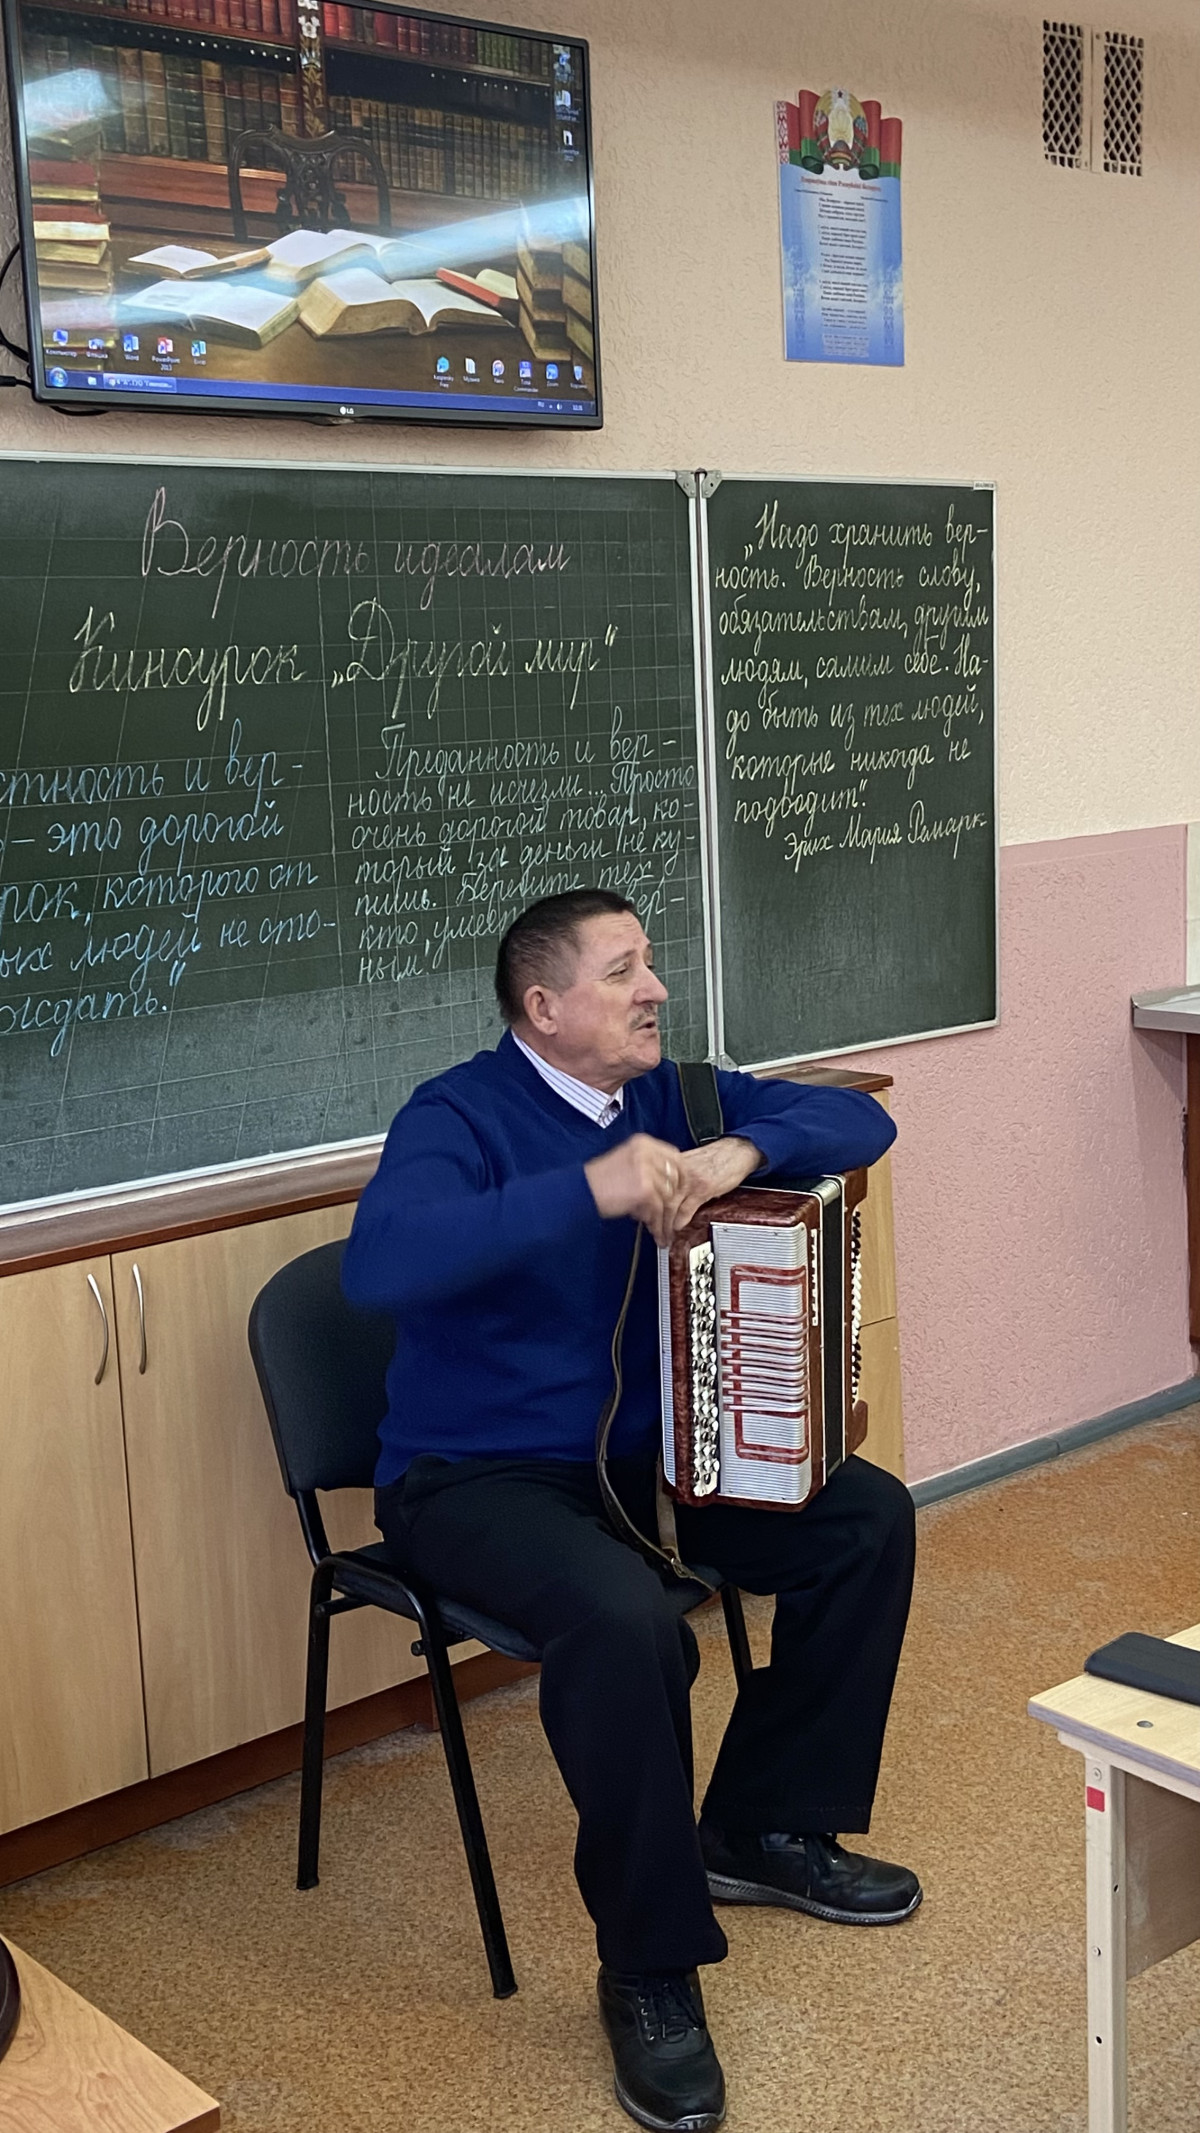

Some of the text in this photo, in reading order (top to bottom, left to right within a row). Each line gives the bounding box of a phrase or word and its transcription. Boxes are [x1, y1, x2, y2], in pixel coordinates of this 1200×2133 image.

[142, 486, 571, 618] Верность идеалам
[829, 522, 933, 568] хранить
[945, 503, 989, 564] вер-
[715, 547, 981, 611] ность. Верность слову,
[719, 593, 989, 657] обязательствам, другим
[70, 607, 307, 731] Киноурок
[721, 632, 989, 708] людям, самим себе. На-
[375, 706, 677, 797] Преданность и вер-
[726, 683, 984, 760] до быть из тех людей,
[186, 758, 211, 792] и
[226, 718, 302, 817] вер-
[348, 786, 433, 818] ность
[448, 779, 475, 810] не
[609, 761, 695, 818] Просто
[731, 738, 971, 796] которые никогда не
[48, 816, 122, 856] это
[140, 801, 285, 877] дорогой
[351, 793, 694, 863] очень дорогой товар, ко-
[355, 829, 695, 893] торый за деньги не ку-
[784, 800, 988, 873] Эрих Мария Ремарк
[103, 867, 259, 924] которого
[269, 861, 319, 890] от
[355, 888, 437, 917] пишь.
[70, 911, 202, 994] людей
[220, 918, 250, 948] не
[359, 920, 430, 957] кто,
